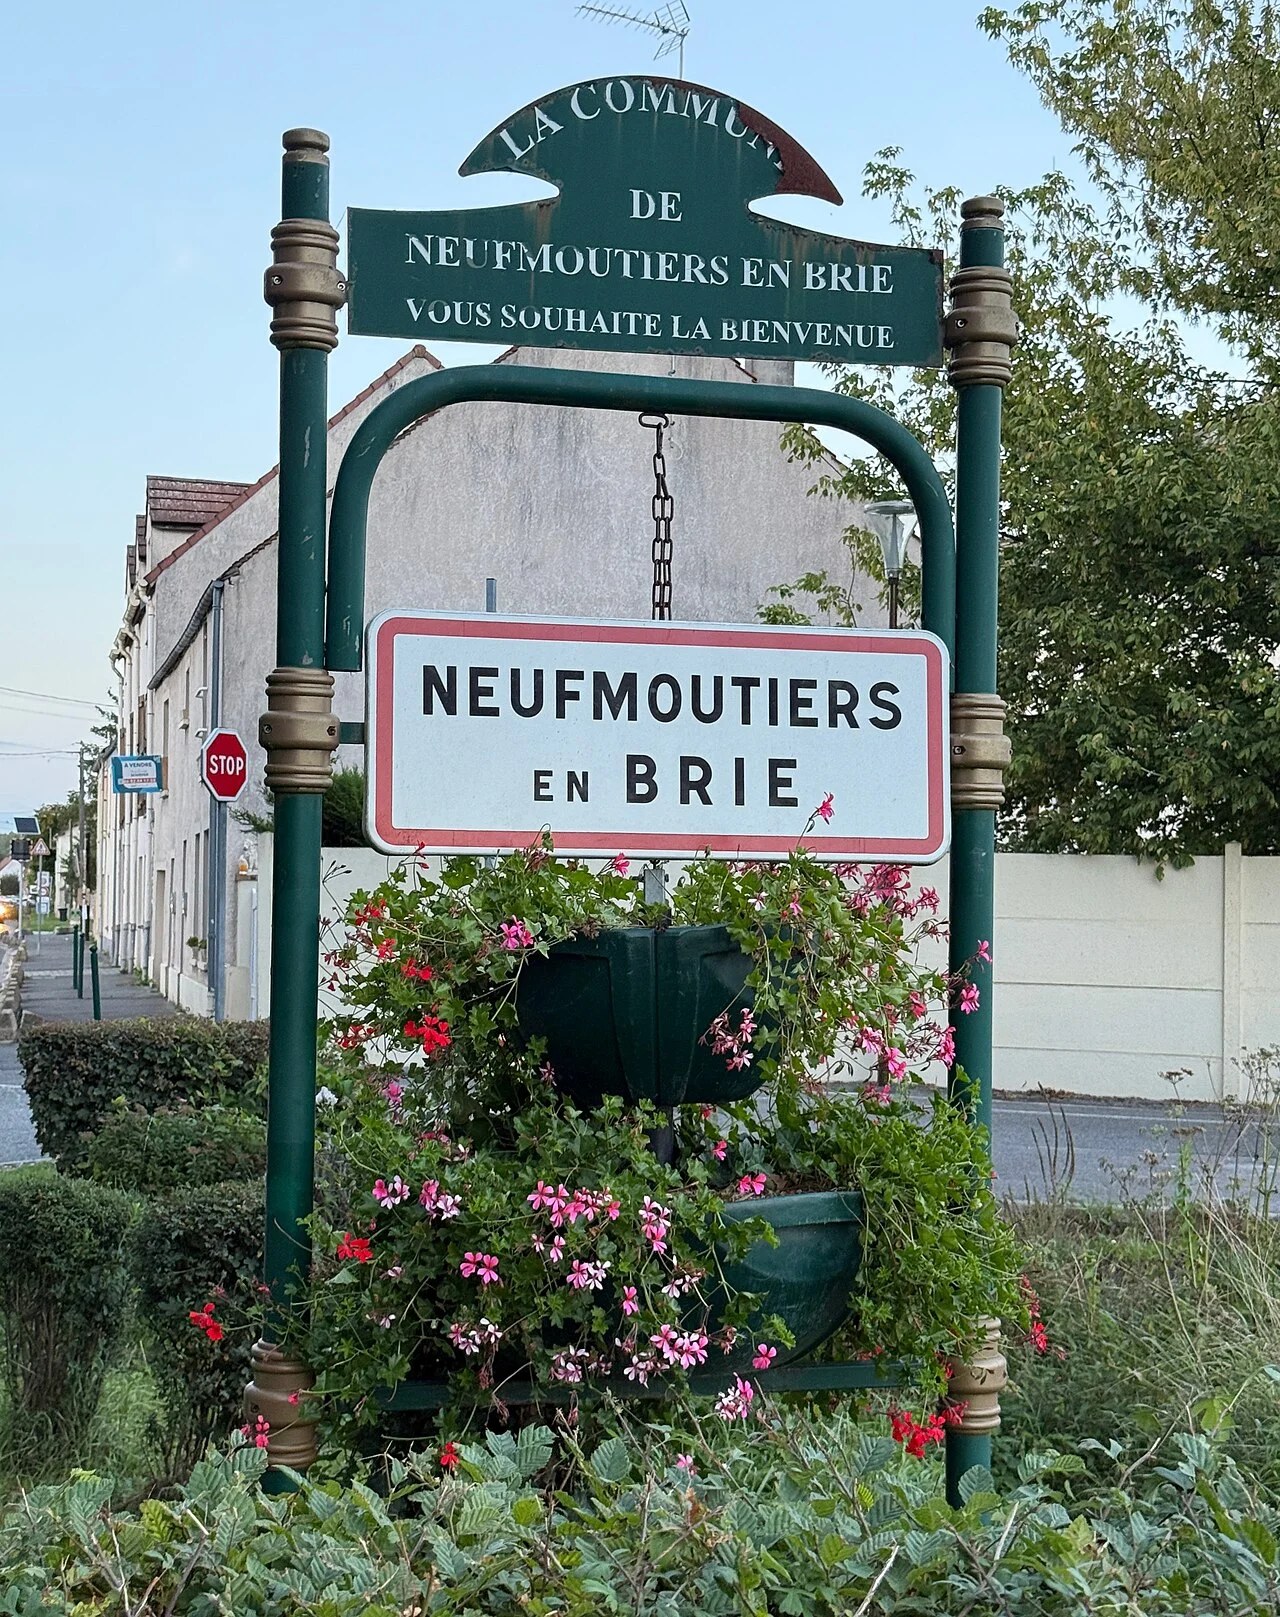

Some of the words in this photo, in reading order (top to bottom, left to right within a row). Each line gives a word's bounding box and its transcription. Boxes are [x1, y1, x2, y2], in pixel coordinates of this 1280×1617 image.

[499, 106, 563, 160] LA
[629, 188, 683, 222] DE
[405, 234, 730, 286] NEUFMOUTIERS
[741, 258, 791, 289] EN
[803, 261, 894, 295] BRIE
[405, 298, 491, 328] VOUS
[500, 305, 662, 338] SOUHAITE
[671, 315, 713, 341] LA
[721, 319, 895, 349] BIENVENUE
[422, 665, 903, 730] NEUFMOUTIERS
[209, 754, 244, 776] STOP
[533, 769, 590, 803] EN
[625, 754, 799, 808] BRIE
